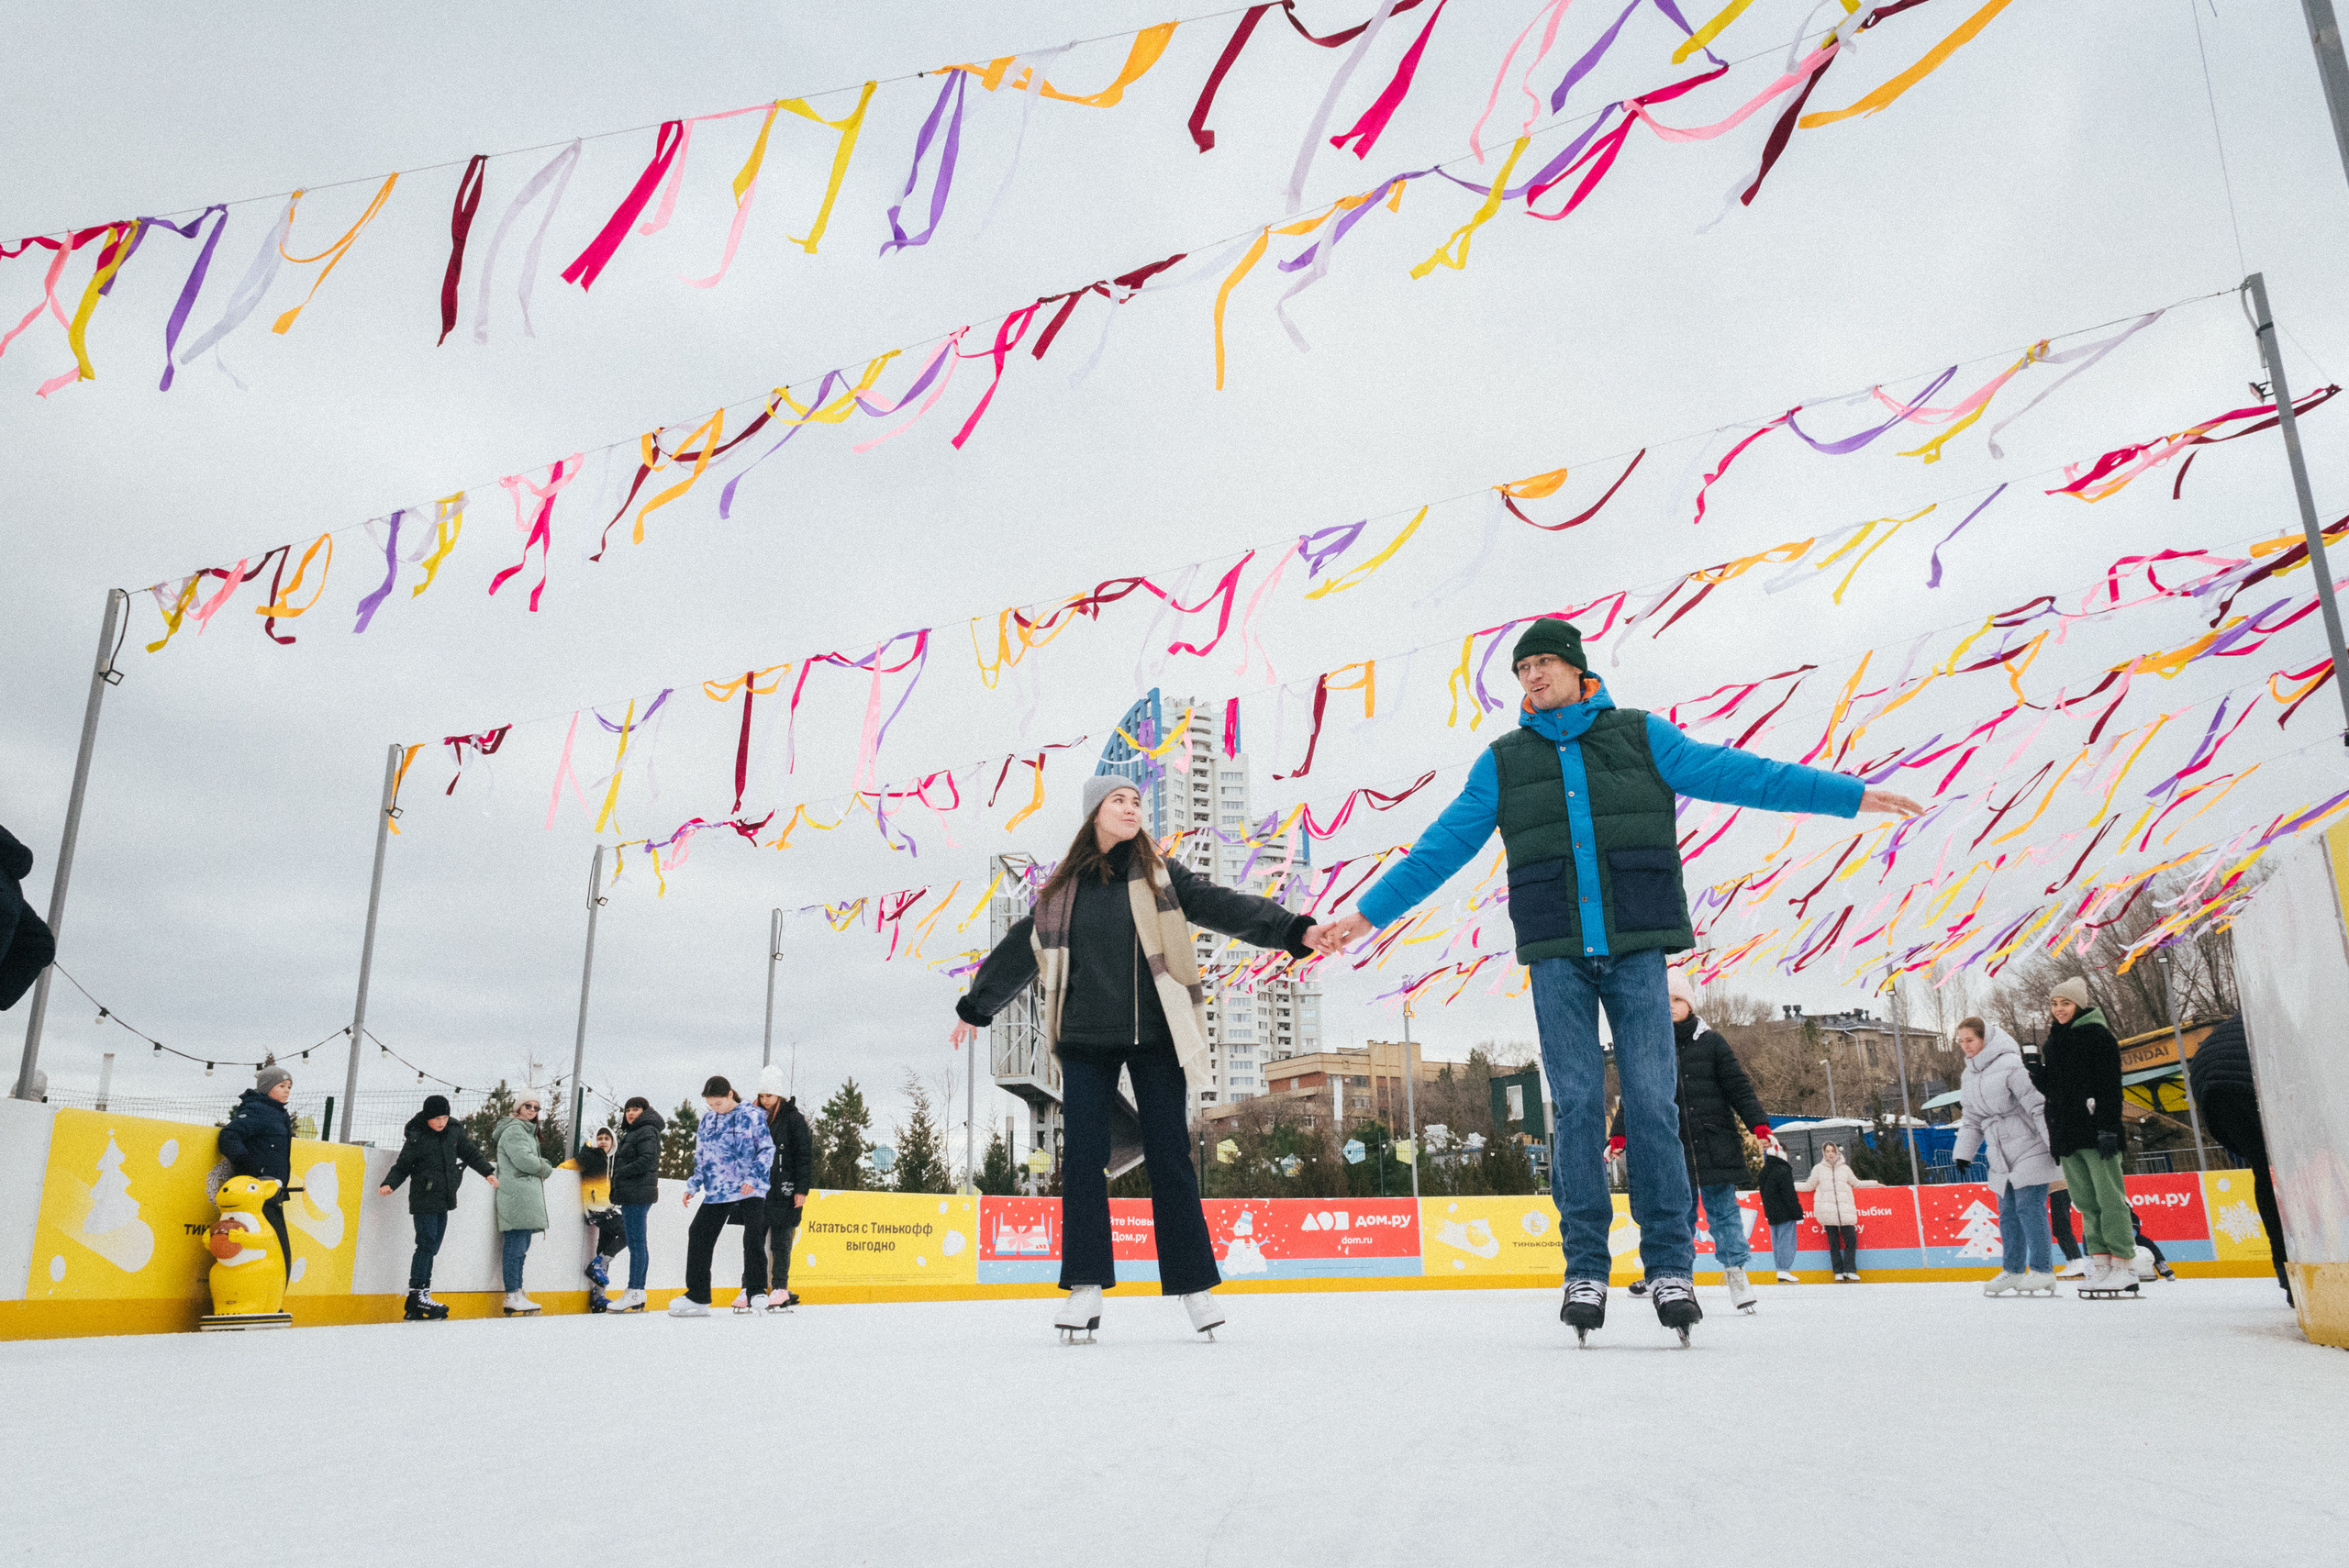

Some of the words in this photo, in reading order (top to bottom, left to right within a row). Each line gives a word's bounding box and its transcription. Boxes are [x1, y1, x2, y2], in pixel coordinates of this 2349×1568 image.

[808, 1220, 859, 1233] Кататься
[862, 1224, 868, 1234] с
[870, 1221, 933, 1237] Тинькофф
[1111, 1230, 1148, 1243] Дом.ру
[1341, 1235, 1373, 1244] dom.ru
[846, 1240, 896, 1253] выгодно
